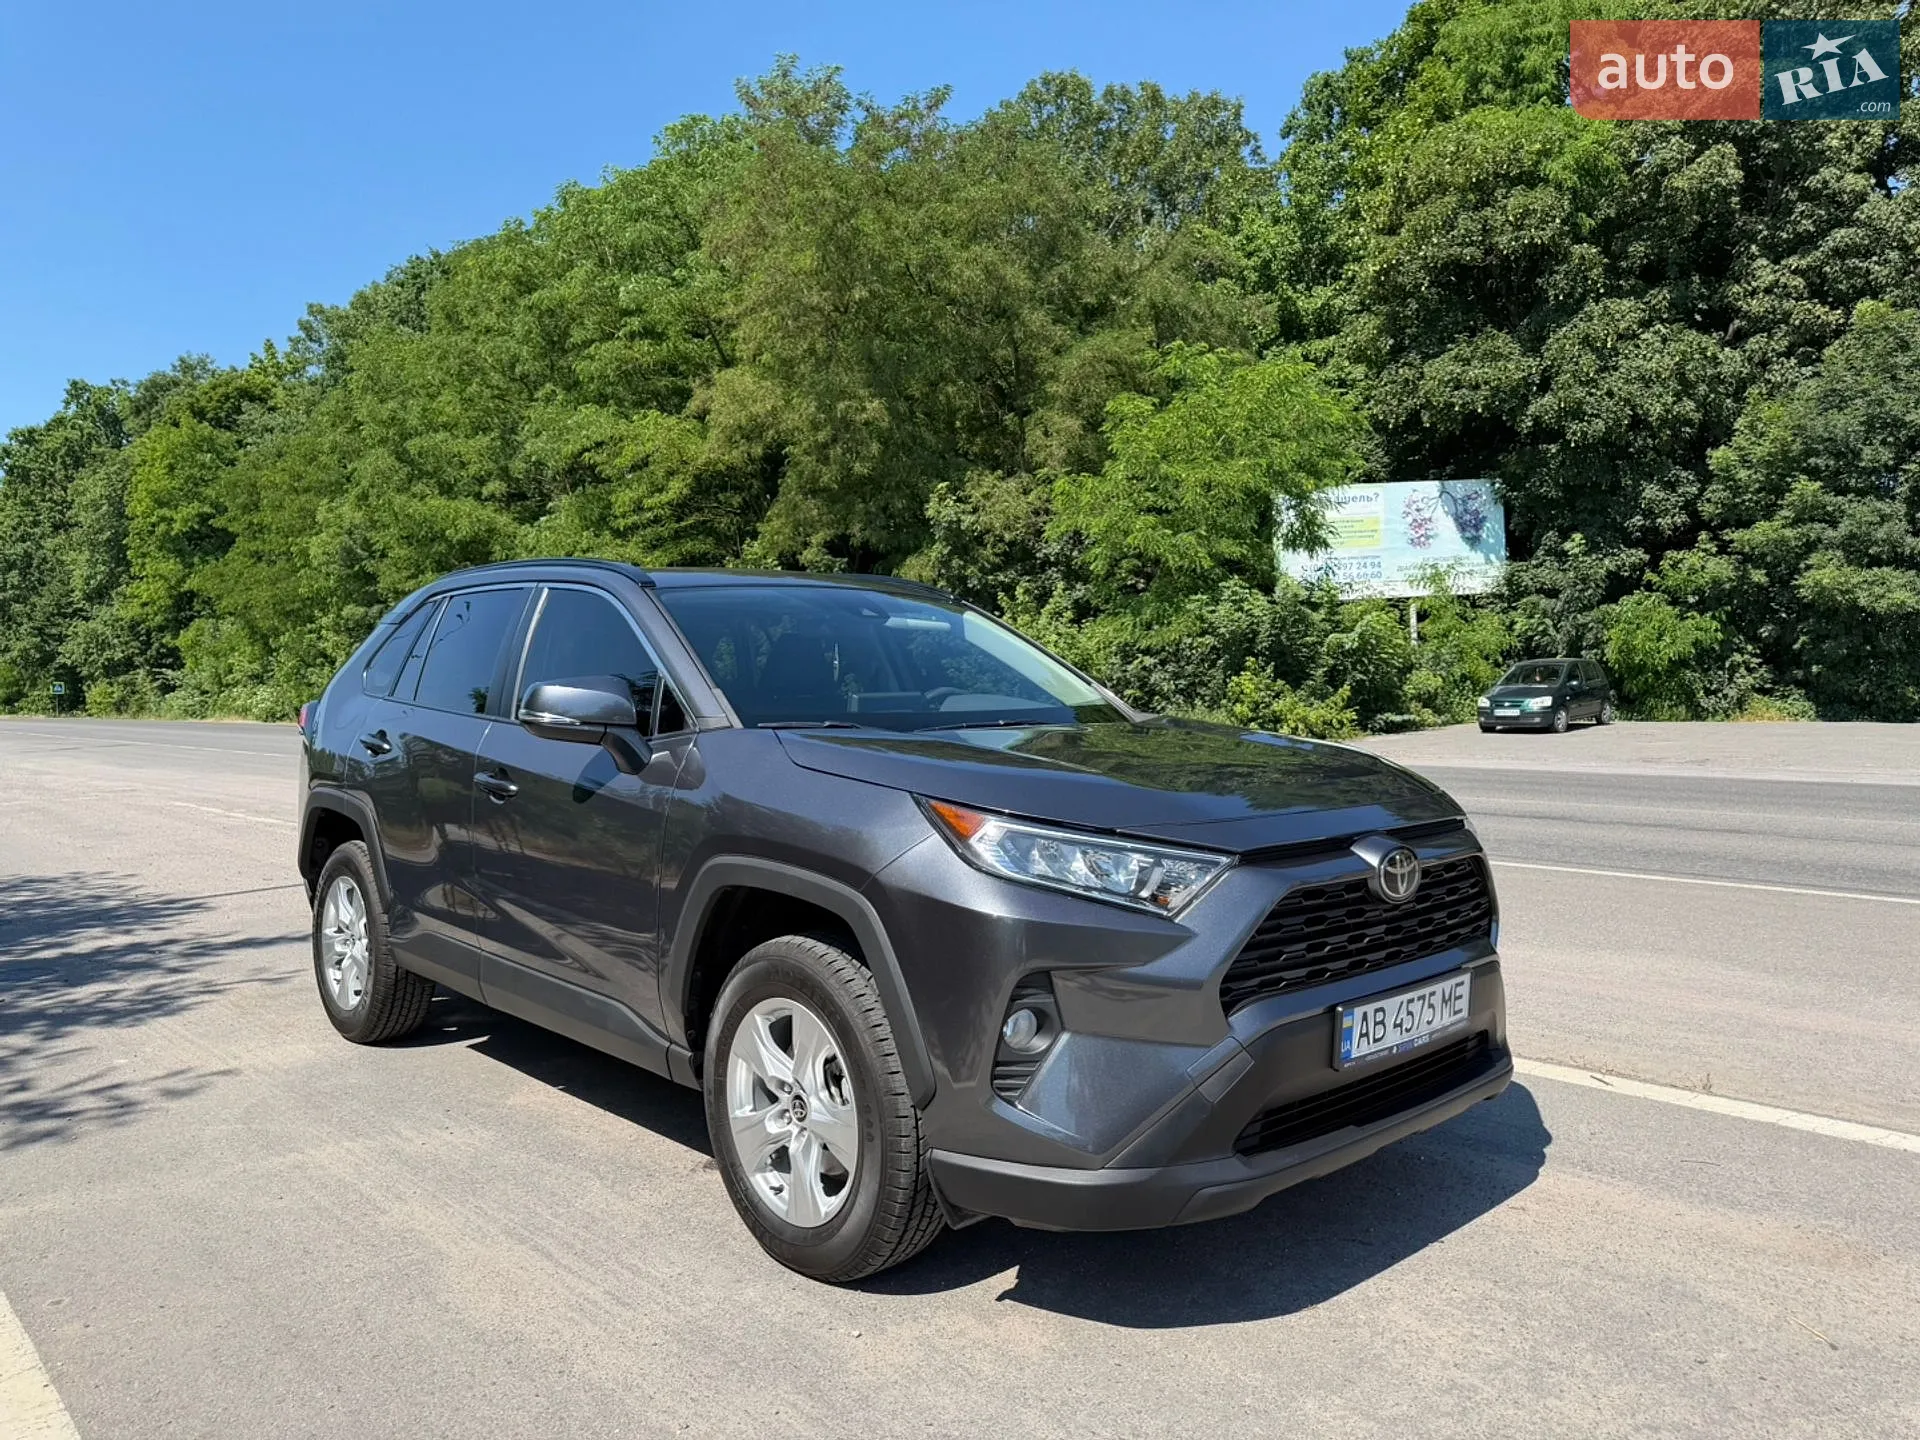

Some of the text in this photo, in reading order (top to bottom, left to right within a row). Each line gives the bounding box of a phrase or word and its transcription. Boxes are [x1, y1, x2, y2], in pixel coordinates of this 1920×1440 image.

[1356, 980, 1465, 1049] AB 4575 ME
[1341, 1040, 1353, 1053] UA
